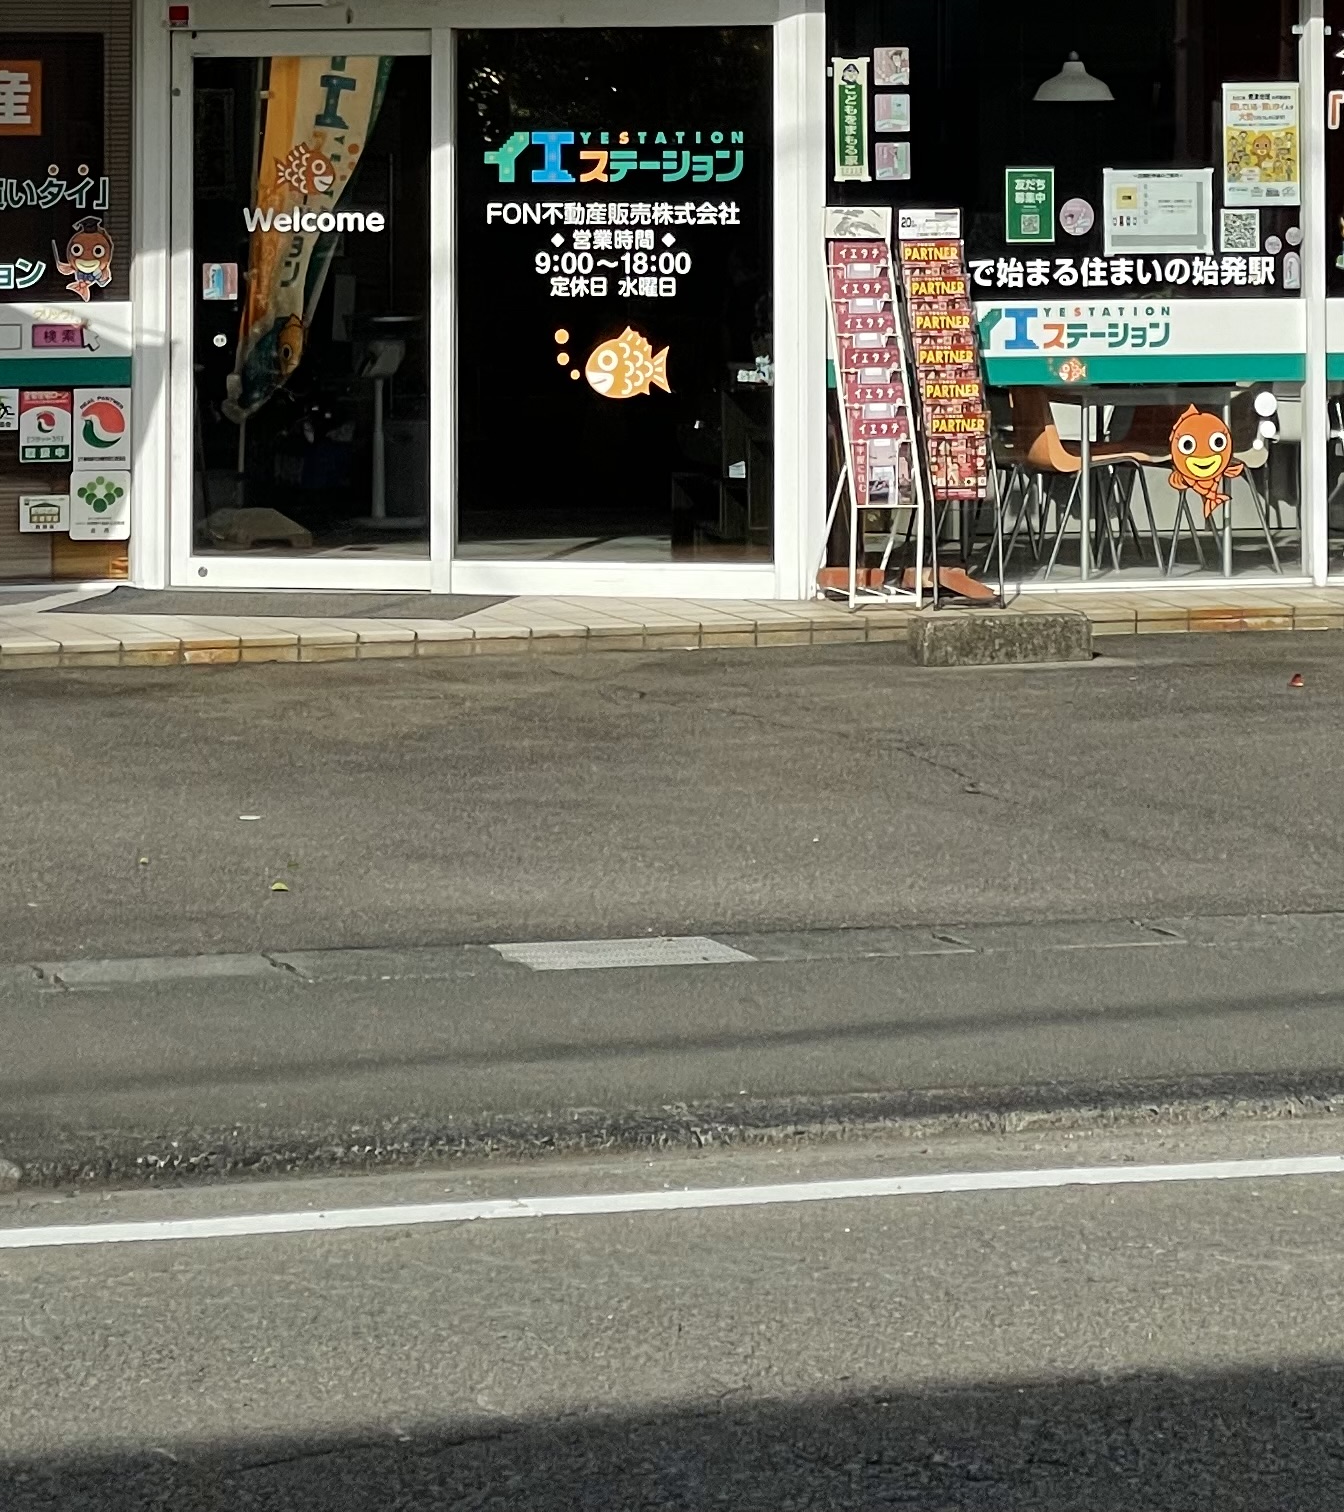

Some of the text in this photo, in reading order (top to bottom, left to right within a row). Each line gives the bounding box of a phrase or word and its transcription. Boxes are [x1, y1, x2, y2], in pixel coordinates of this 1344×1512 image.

[579, 131, 744, 144] YESTATION
[483, 131, 744, 182] イエステーション
[242, 206, 385, 232] Welcome
[486, 201, 741, 225] FON不動産販売株式会社
[572, 229, 655, 250] 営業時間
[904, 246, 958, 261] PARTNER
[968, 256, 1275, 288] で始まる住まいの始発駅
[549, 277, 676, 298] 定休日 水曜日
[912, 282, 965, 295] PARTNER
[1043, 306, 1170, 317] YESTATION
[916, 316, 970, 329] PARTNER
[43, 329, 76, 343] 検索
[920, 350, 974, 364] PARTNER
[926, 384, 980, 398] PARTNER
[932, 418, 985, 433] PARTNER
